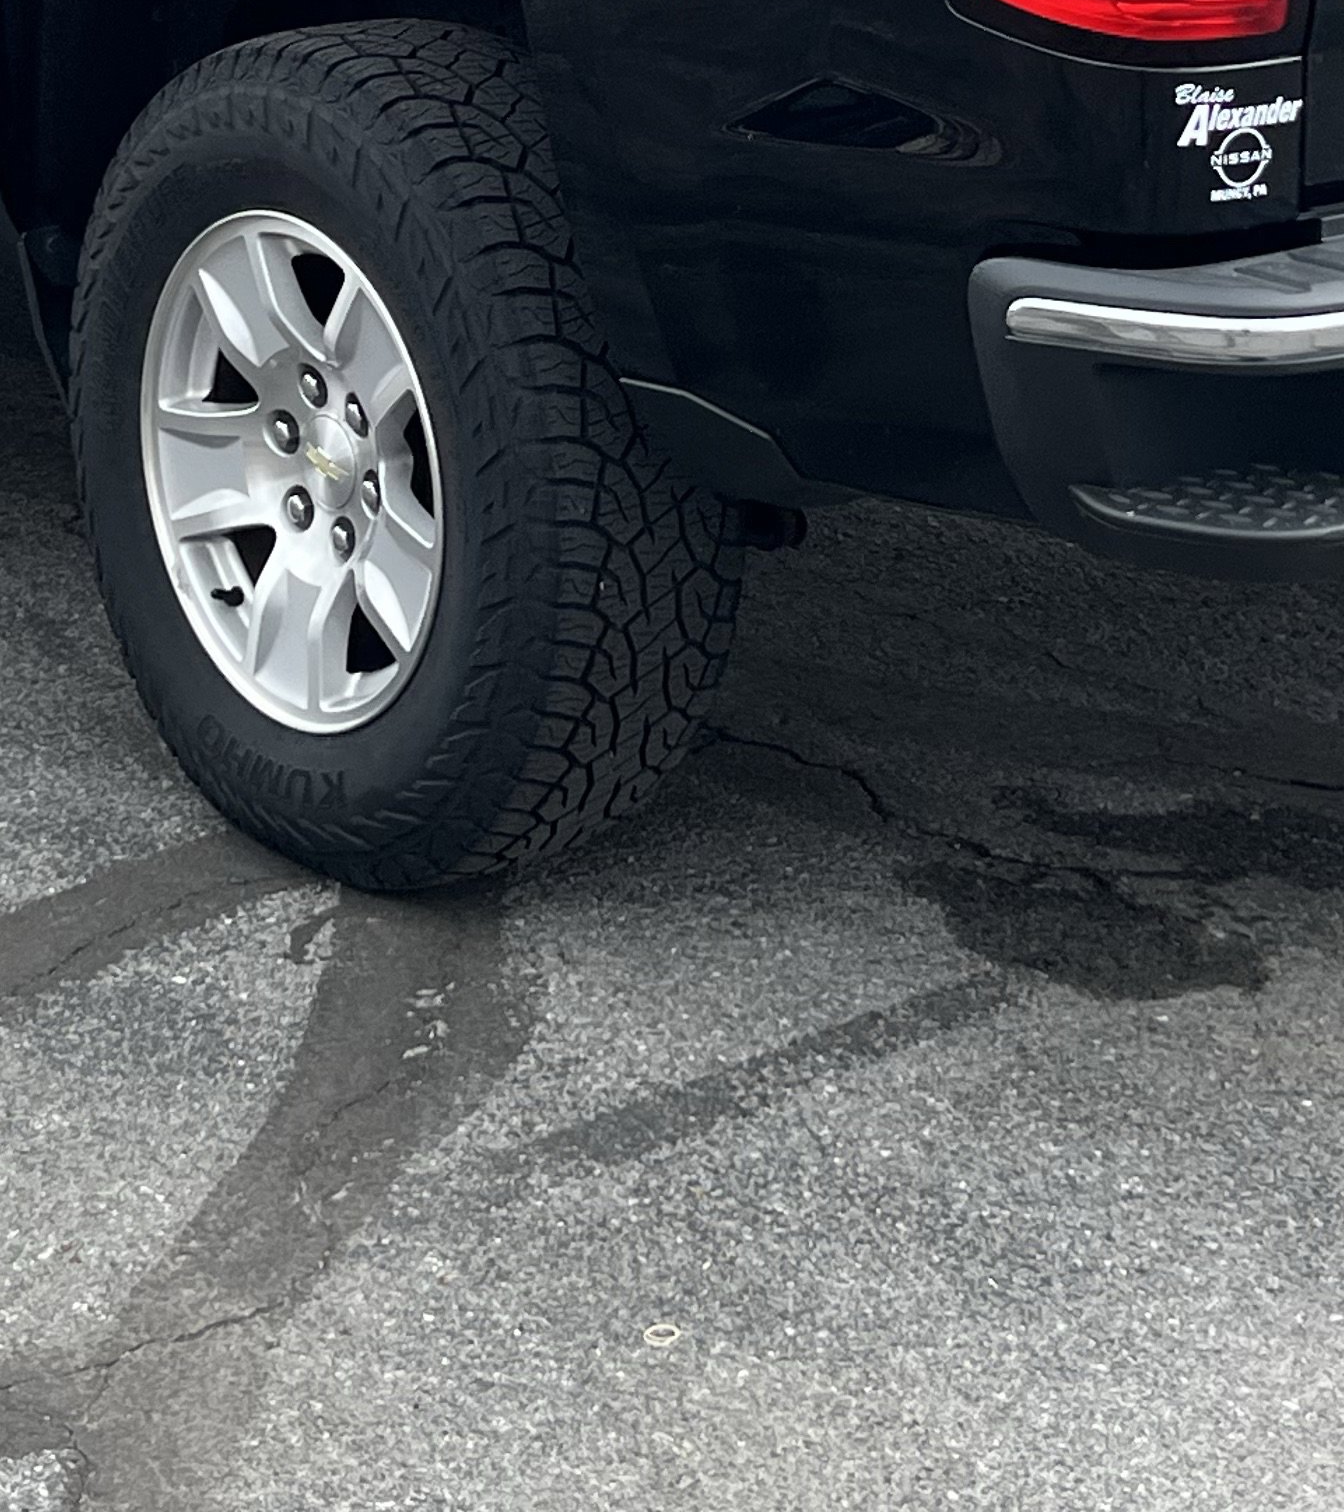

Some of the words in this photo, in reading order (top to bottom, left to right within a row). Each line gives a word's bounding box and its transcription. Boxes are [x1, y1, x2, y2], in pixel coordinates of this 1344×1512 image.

[1174, 83, 1235, 105] Blaise
[1176, 96, 1304, 147] Alexander
[1210, 146, 1273, 167] NISSAN
[196, 714, 345, 808] KUMHO
